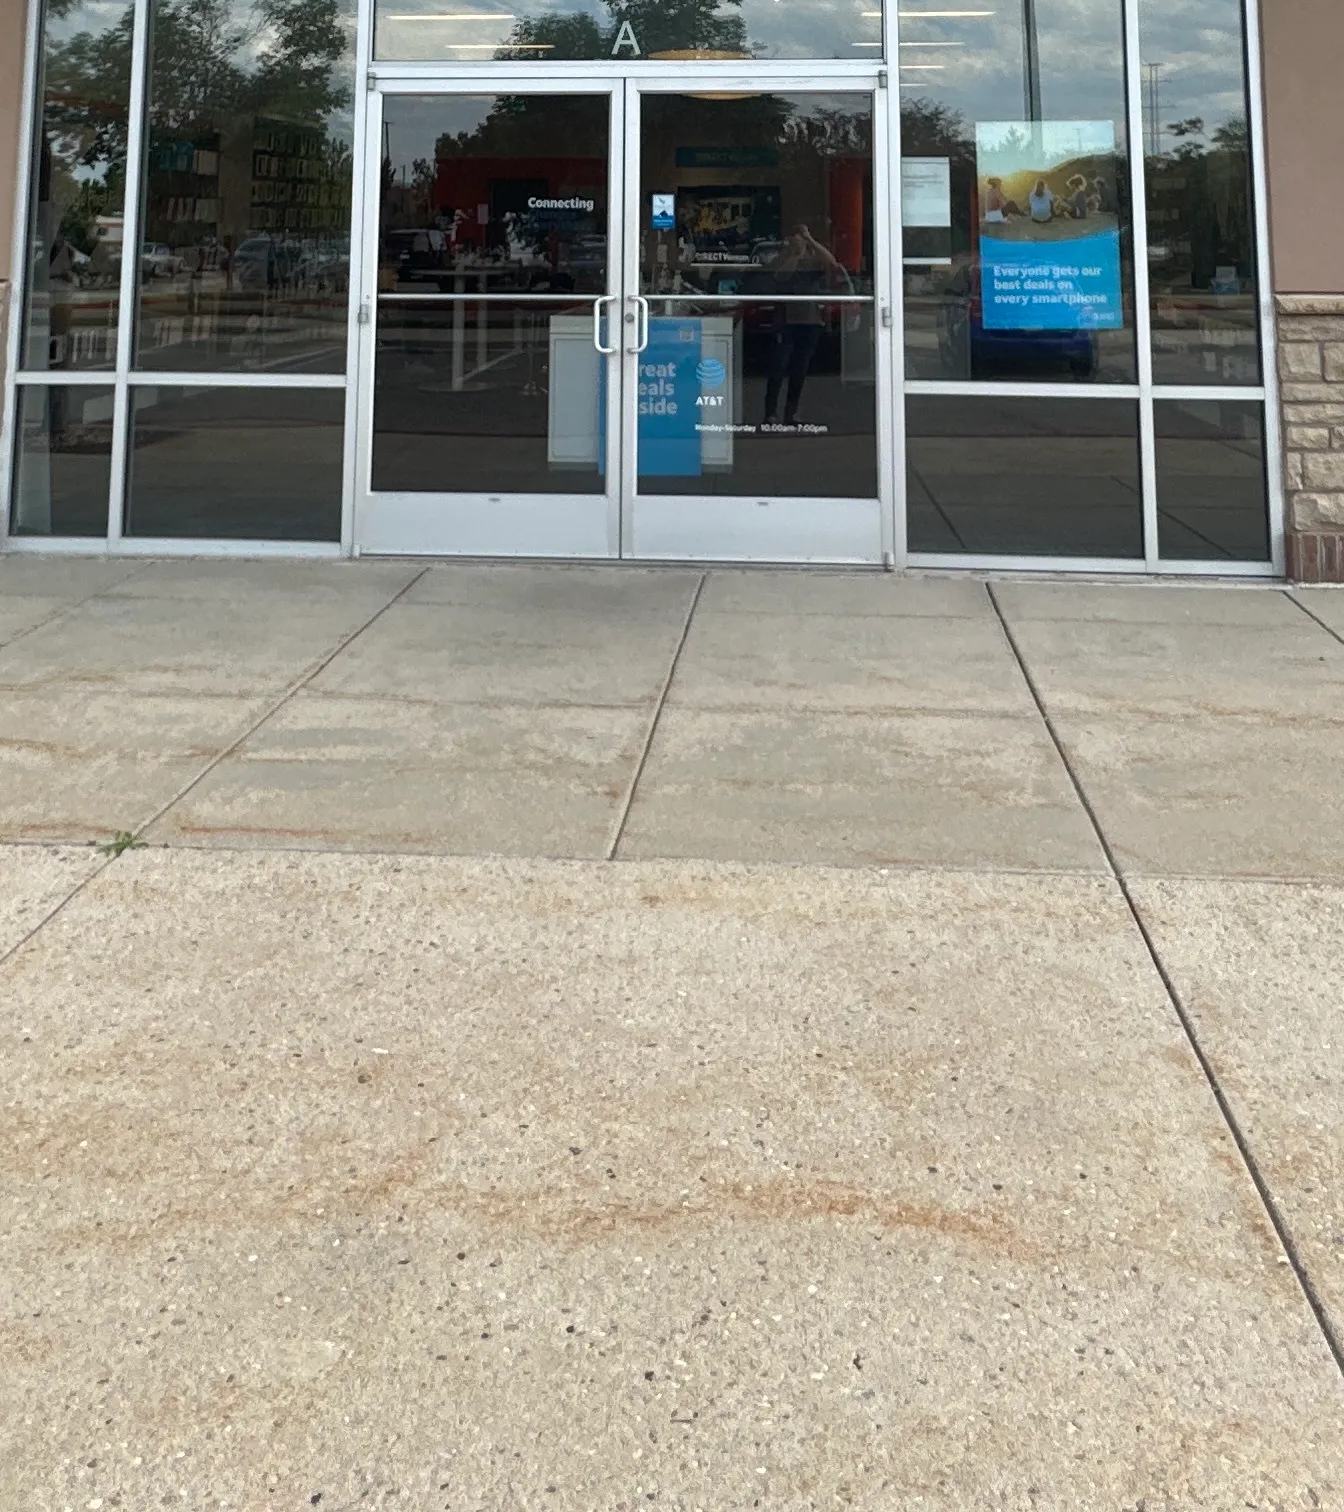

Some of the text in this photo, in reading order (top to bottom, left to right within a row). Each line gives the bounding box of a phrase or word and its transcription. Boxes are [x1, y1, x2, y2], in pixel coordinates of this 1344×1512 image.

[611, 20, 642, 55] A
[527, 196, 595, 212] Connecting
[993, 265, 1103, 279] Everyone gets our
[994, 278, 1074, 291] best deals on
[994, 292, 1107, 306] every smartphone
[639, 362, 677, 378] reat
[639, 379, 675, 396] eals
[639, 398, 678, 416] side
[695, 395, 725, 406] AT&T
